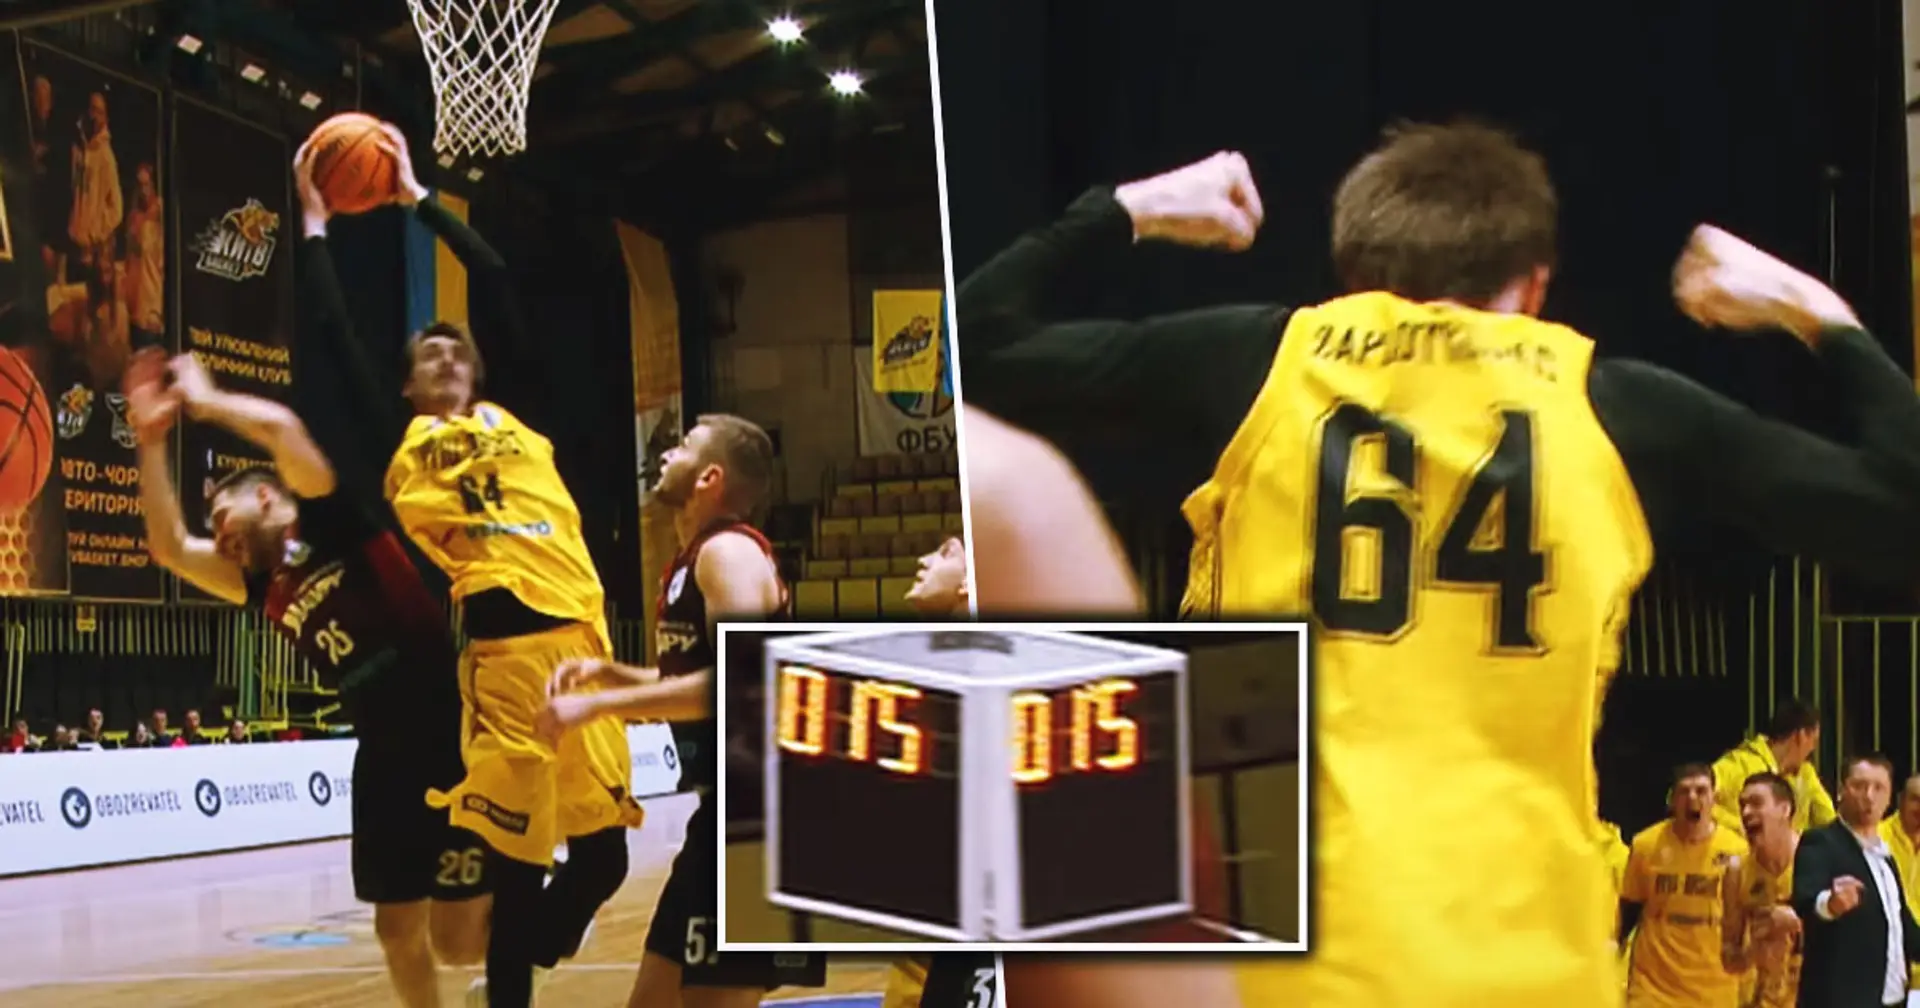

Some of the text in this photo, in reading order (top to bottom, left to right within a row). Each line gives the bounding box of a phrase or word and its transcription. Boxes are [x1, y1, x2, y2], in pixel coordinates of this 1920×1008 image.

[896, 425, 957, 455] ФБУ
[460, 473, 506, 515] 64
[1306, 397, 1556, 657] 64
[94, 790, 182, 818] OBOZREVATEL
[223, 781, 298, 807] OBOZREVATEL
[436, 847, 485, 887] 26
[965, 967, 999, 1008] 3
